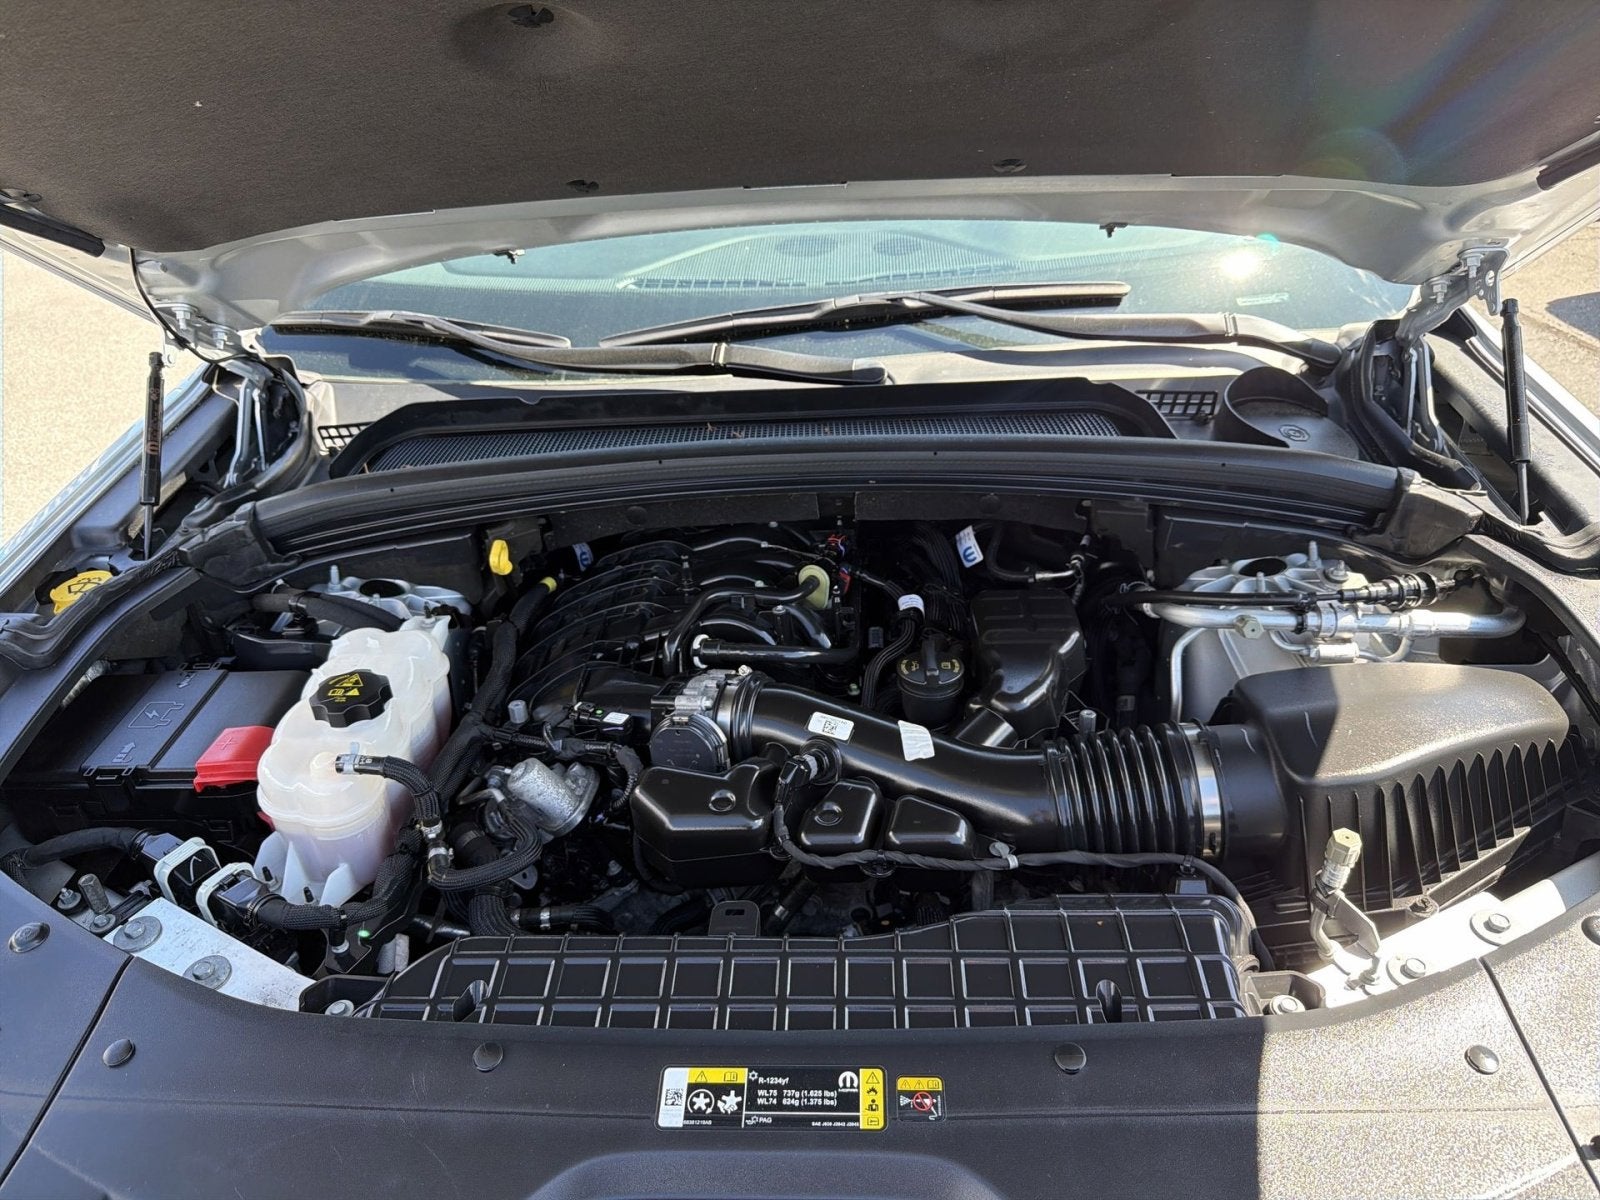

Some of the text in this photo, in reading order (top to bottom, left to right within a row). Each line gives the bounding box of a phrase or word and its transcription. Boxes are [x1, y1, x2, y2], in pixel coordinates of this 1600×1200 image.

[758, 1077, 789, 1085] R-1234yf
[757, 1089, 778, 1097] WL75
[783, 1089, 800, 1098] 737g
[801, 1089, 822, 1098] (1.625
[823, 1089, 838, 1098] lbs)
[801, 1098, 822, 1106] (1.375
[823, 1098, 837, 1106] lbs)
